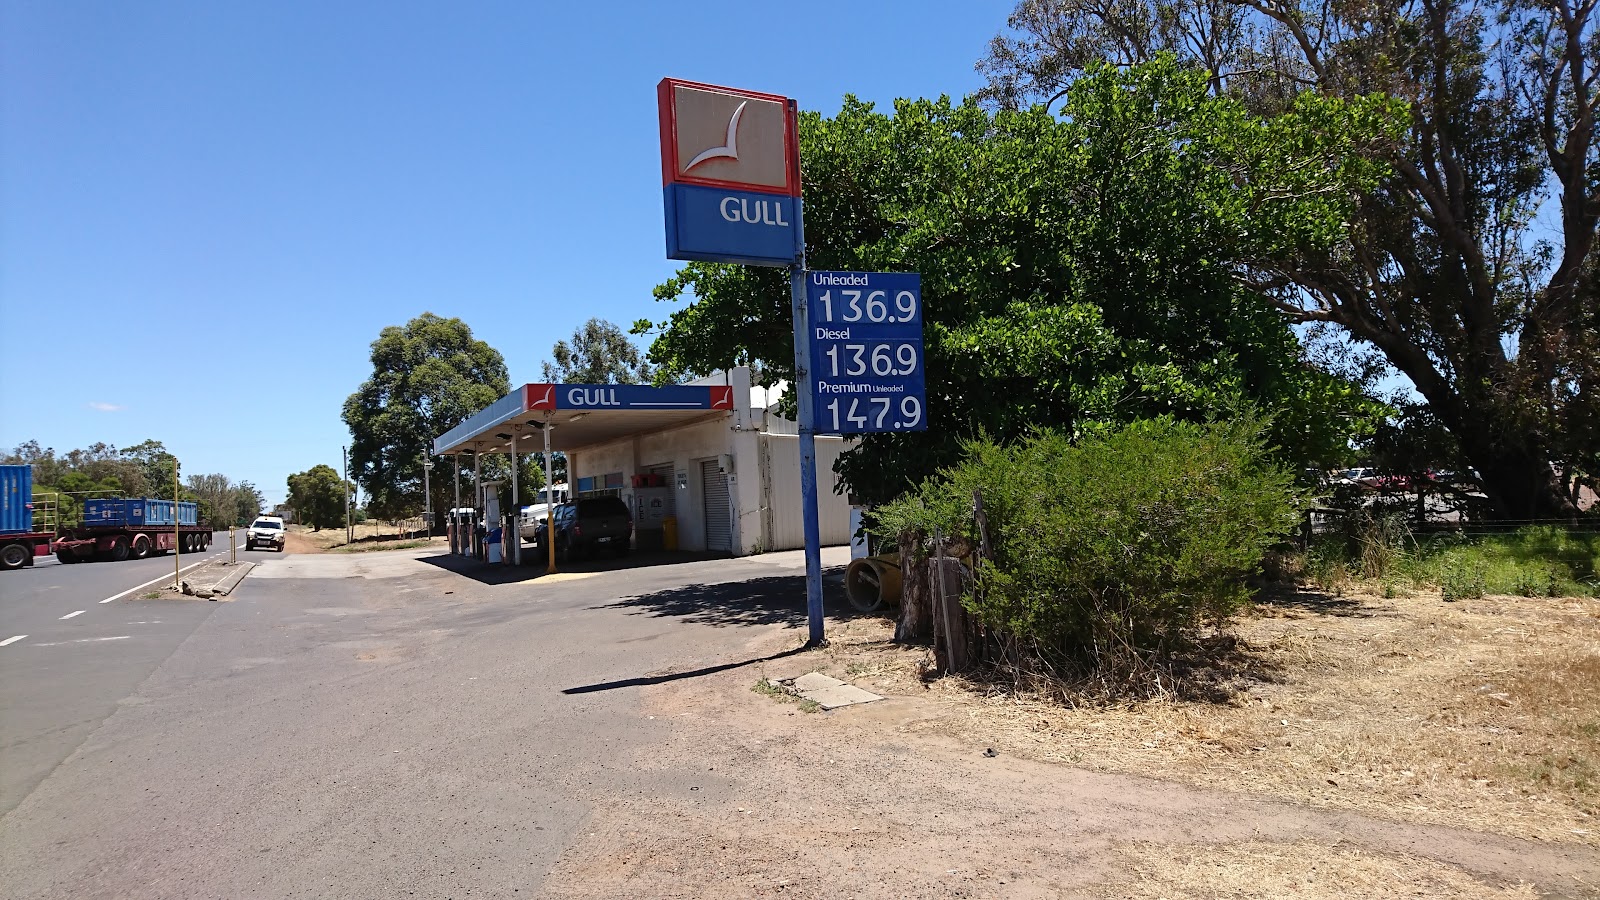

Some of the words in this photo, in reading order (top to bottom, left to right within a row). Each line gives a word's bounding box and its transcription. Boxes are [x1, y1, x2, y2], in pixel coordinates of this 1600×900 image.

[720, 196, 789, 227] GULL
[813, 273, 868, 286] Unleaded
[820, 289, 917, 323] 136.9
[816, 327, 850, 340] Diesel
[826, 343, 917, 377] 136.9
[567, 387, 621, 406] GULL
[818, 381, 872, 393] Premium
[872, 385, 904, 393] Unleaded
[827, 396, 922, 430] 147.9
